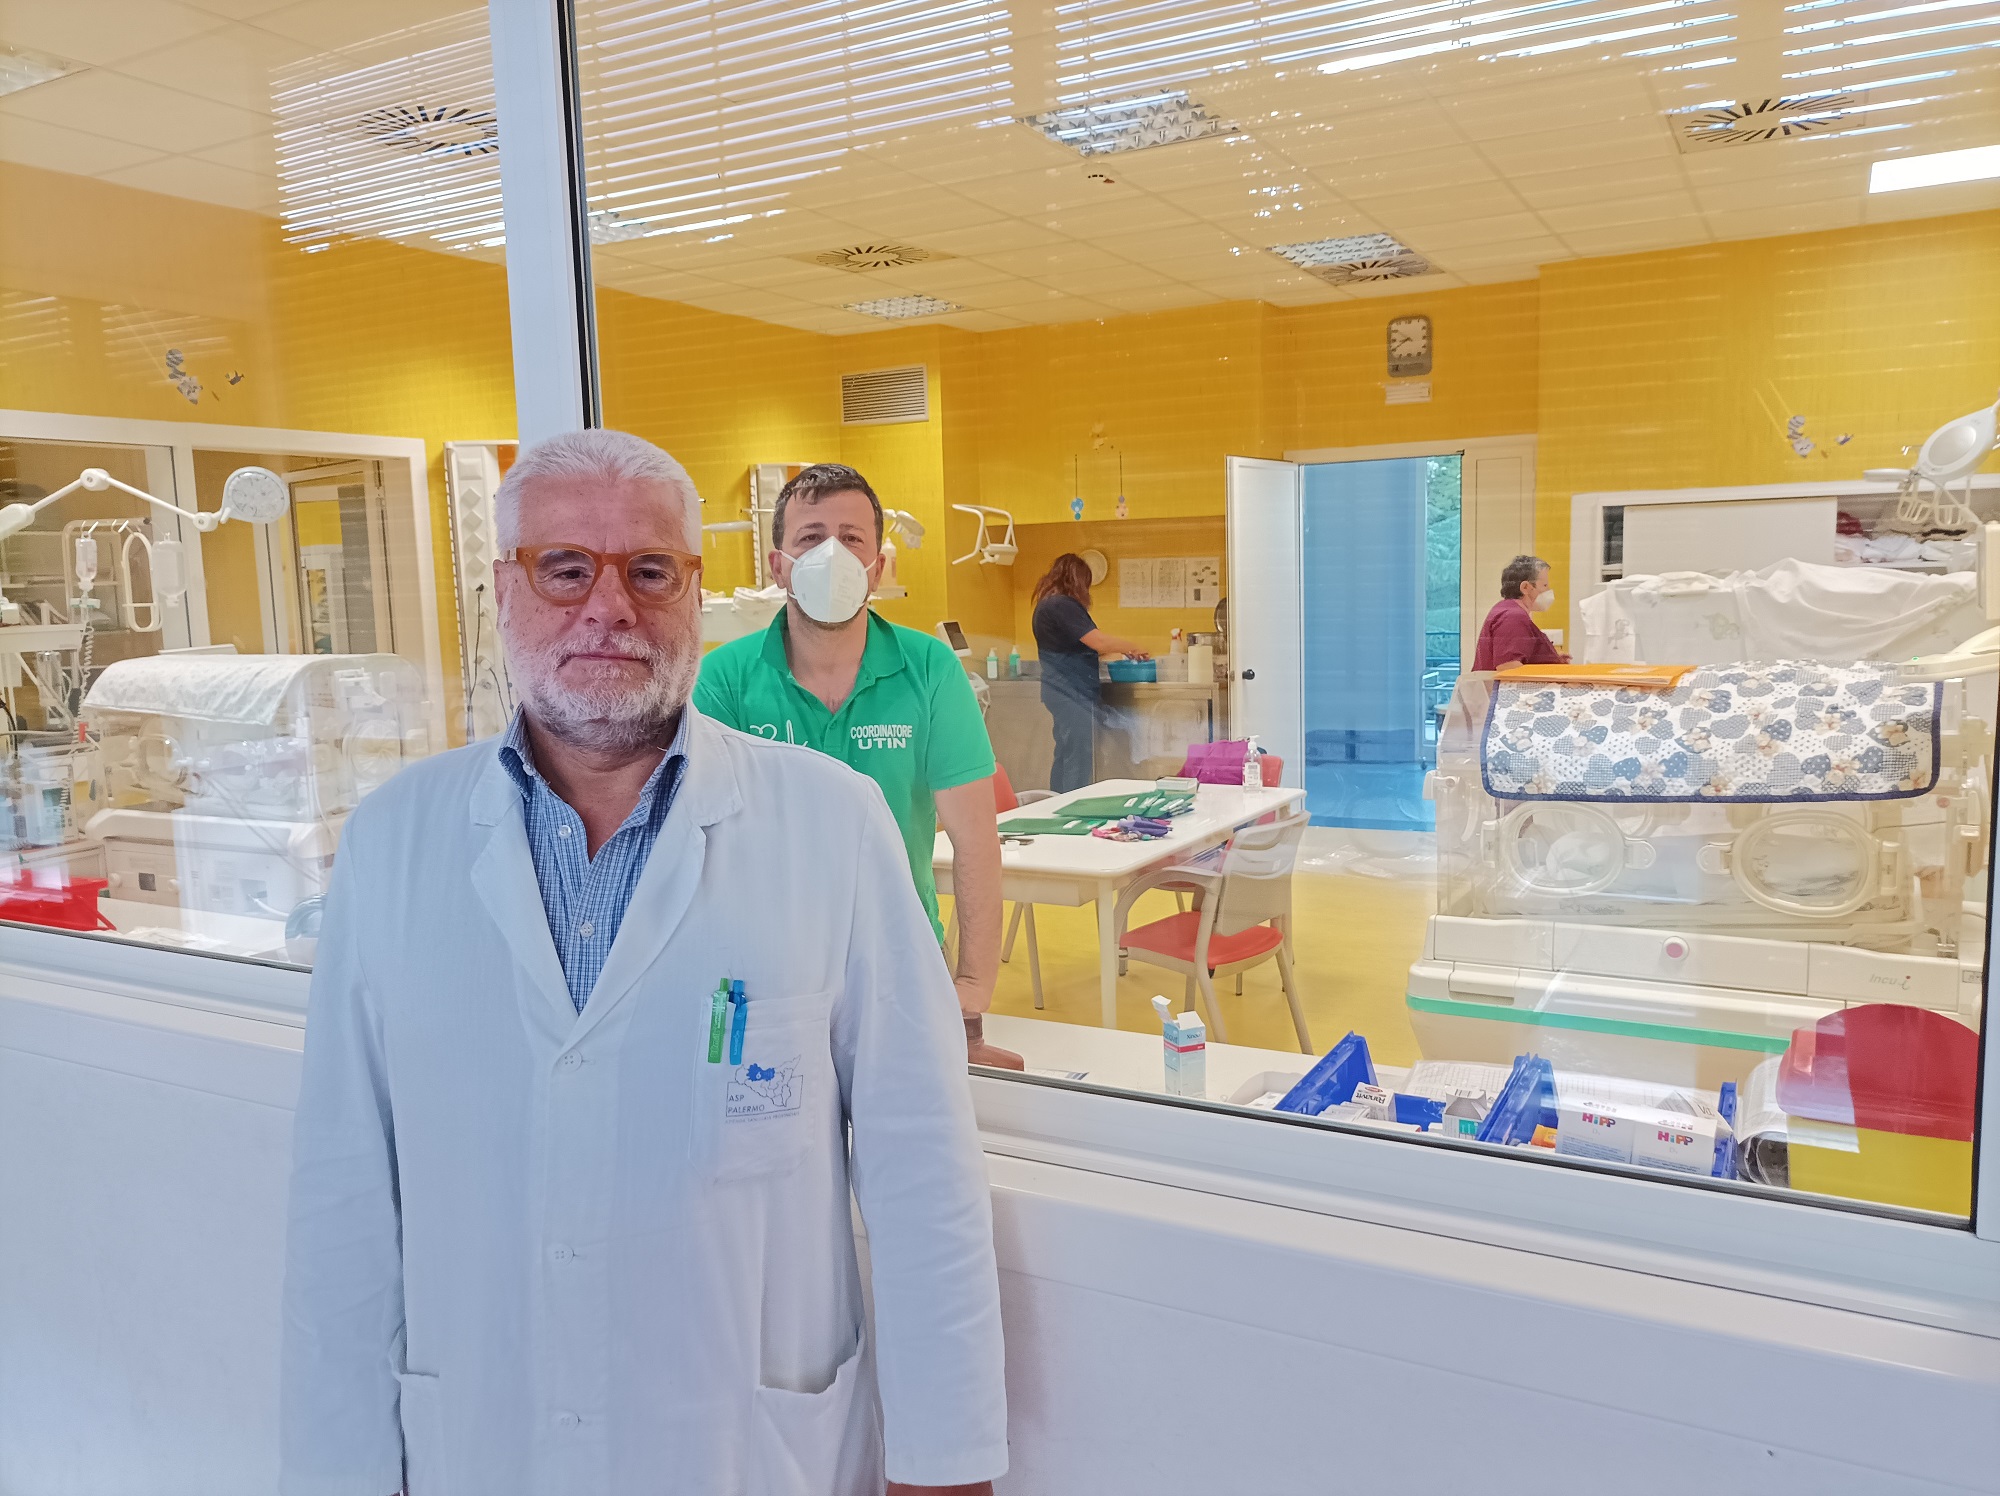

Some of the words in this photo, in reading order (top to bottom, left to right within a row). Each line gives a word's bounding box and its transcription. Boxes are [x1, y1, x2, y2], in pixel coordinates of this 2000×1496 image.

[850, 724, 913, 739] COORDINATORE
[858, 737, 907, 750] UTIN
[729, 1094, 745, 1102] ASP
[727, 1104, 765, 1114] PALERMO
[1582, 1112, 1616, 1128] HiPP
[1657, 1130, 1694, 1146] HiPP
